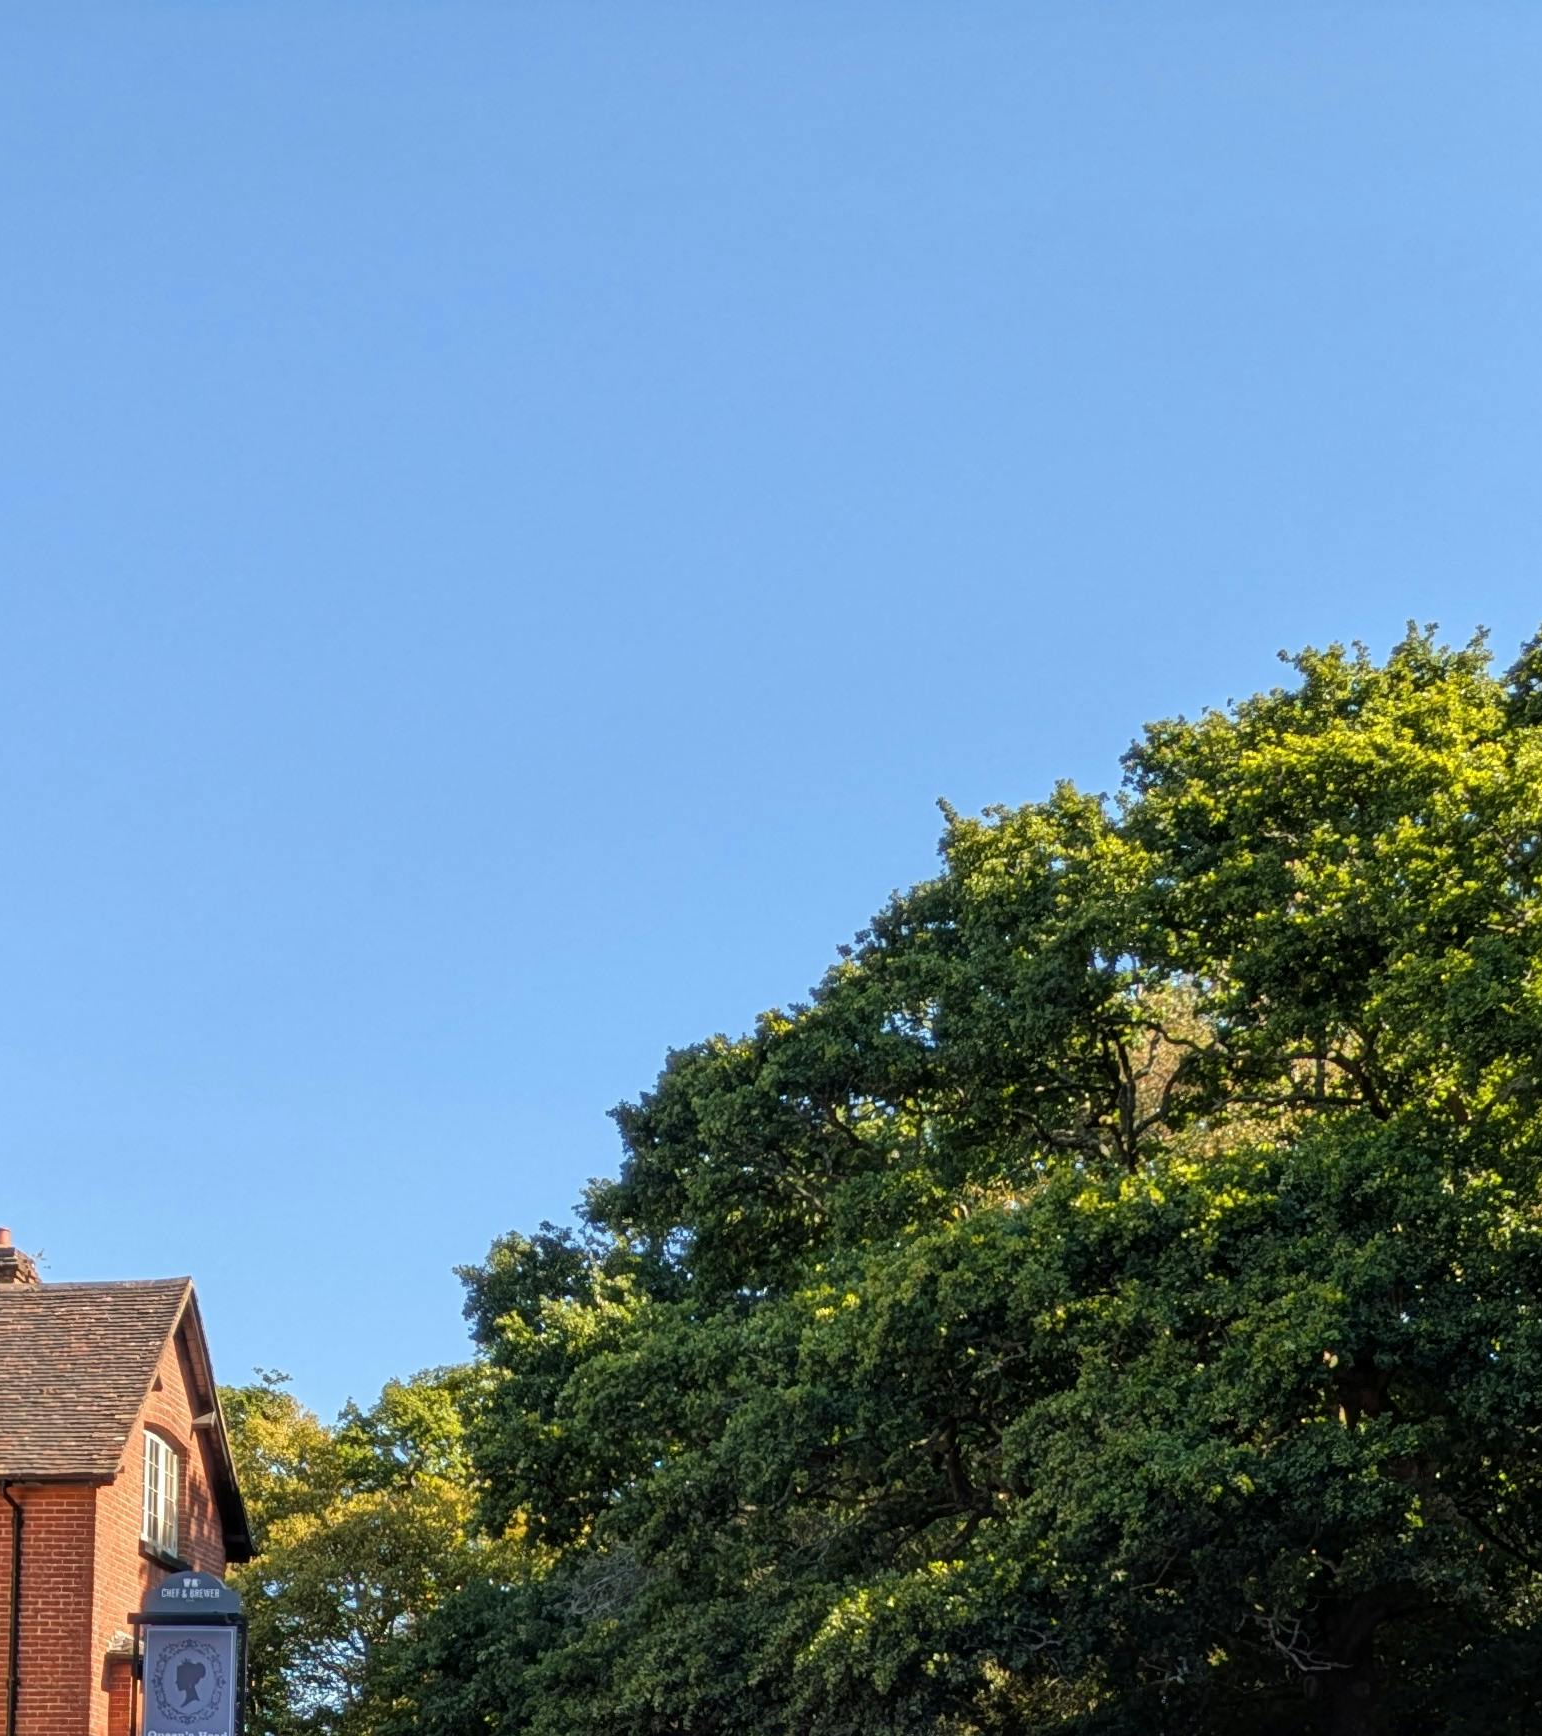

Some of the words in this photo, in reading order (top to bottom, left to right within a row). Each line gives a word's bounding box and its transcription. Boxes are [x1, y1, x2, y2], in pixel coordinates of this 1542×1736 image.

[161, 1588, 180, 1599] CHEF
[181, 1588, 188, 1599] &
[189, 1588, 220, 1599] BREWER
